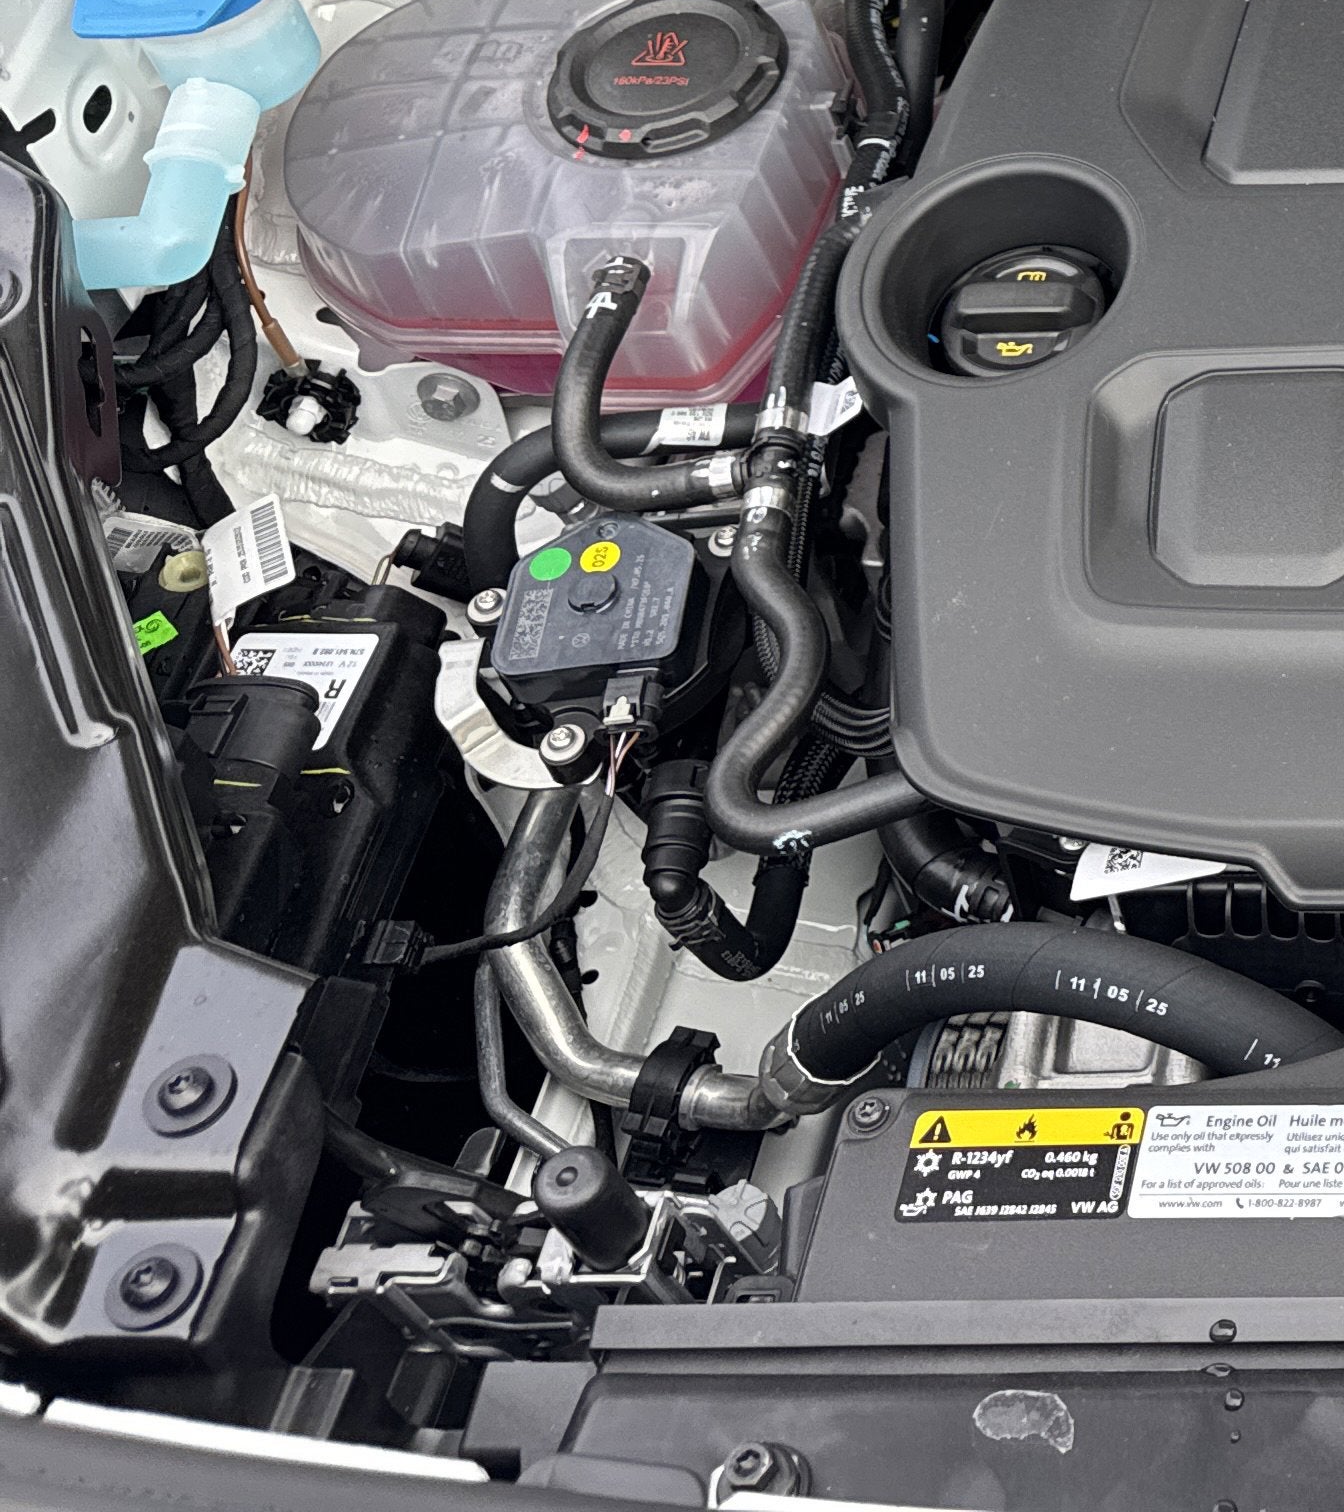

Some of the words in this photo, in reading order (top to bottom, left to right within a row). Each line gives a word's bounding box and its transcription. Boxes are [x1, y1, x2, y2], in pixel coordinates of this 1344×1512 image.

[324, 679, 347, 699] R
[1206, 1114, 1254, 1130] Engine
[1257, 1114, 1278, 1127] Oil
[1289, 1113, 1327, 1127] Huile
[1151, 1132, 1170, 1141] Use
[1171, 1131, 1192, 1143] only
[1193, 1131, 1206, 1141] oil
[1207, 1131, 1228, 1141] that
[1229, 1131, 1274, 1143] expressly
[1286, 1132, 1323, 1142] Utilisez
[1148, 1144, 1191, 1155] complies
[1193, 1143, 1216, 1153] with
[1284, 1144, 1301, 1154] qui
[1302, 1143, 1342, 1153] satisfait
[951, 1150, 1014, 1169] R-1234yf
[1044, 1152, 1081, 1164] 0.460
[1082, 1152, 1098, 1165] kg
[1194, 1162, 1221, 1175] VW
[1224, 1162, 1251, 1175] 508
[1255, 1162, 1276, 1174] 00
[1282, 1163, 1295, 1174] &
[1302, 1161, 1330, 1175] SAE
[948, 1170, 973, 1180] GWP
[973, 1170, 981, 1179] 4
[1141, 1179, 1157, 1189] For
[1167, 1179, 1183, 1188] list
[1185, 1178, 1197, 1188] of
[1196, 1179, 1243, 1191] approved
[1278, 1179, 1301, 1189] Pour
[1302, 1180, 1322, 1188] une
[1323, 1178, 1343, 1188] liste
[942, 1189, 974, 1205] PAG
[1071, 1201, 1095, 1214] VW
[1096, 1199, 1119, 1214] AG
[1158, 1199, 1223, 1208] www.vw.com
[954, 1205, 974, 1217] SAE
